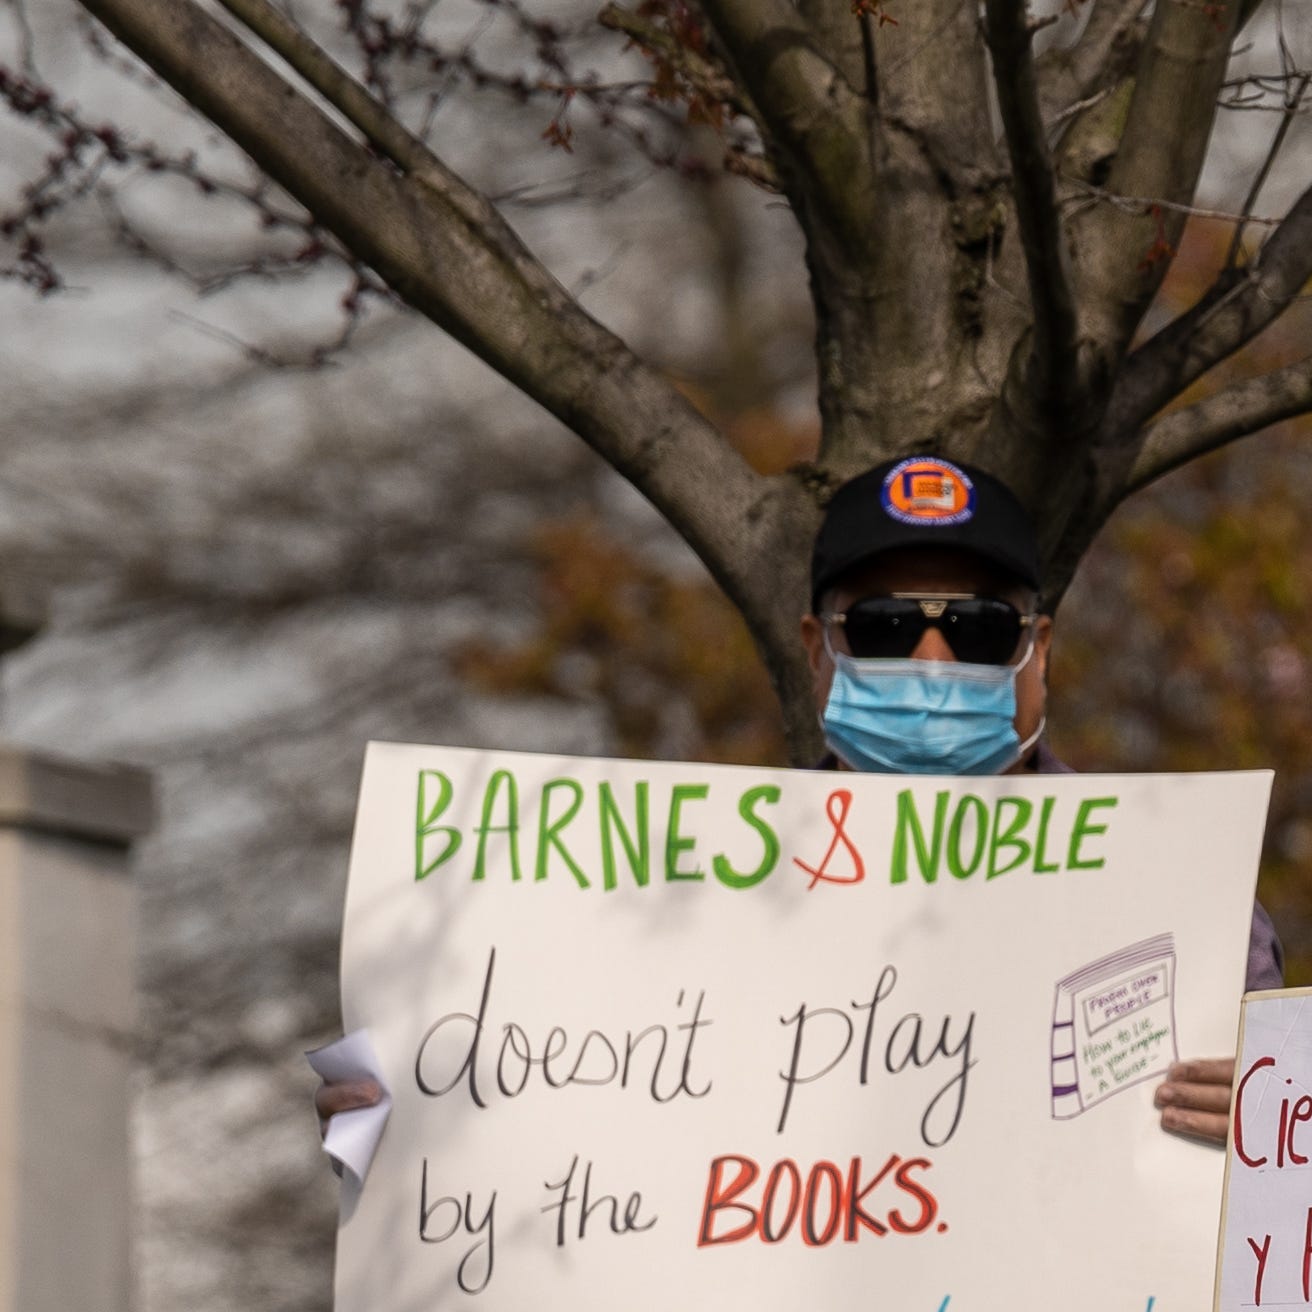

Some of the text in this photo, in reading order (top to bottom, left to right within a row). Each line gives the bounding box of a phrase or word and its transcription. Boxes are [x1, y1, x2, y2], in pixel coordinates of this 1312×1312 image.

[415, 770, 1118, 892] BARNES & NOBLE
[415, 947, 977, 1147] doesn't play
[420, 1154, 948, 1294] by the BOOKS.
[1247, 1234, 1271, 1306] y
